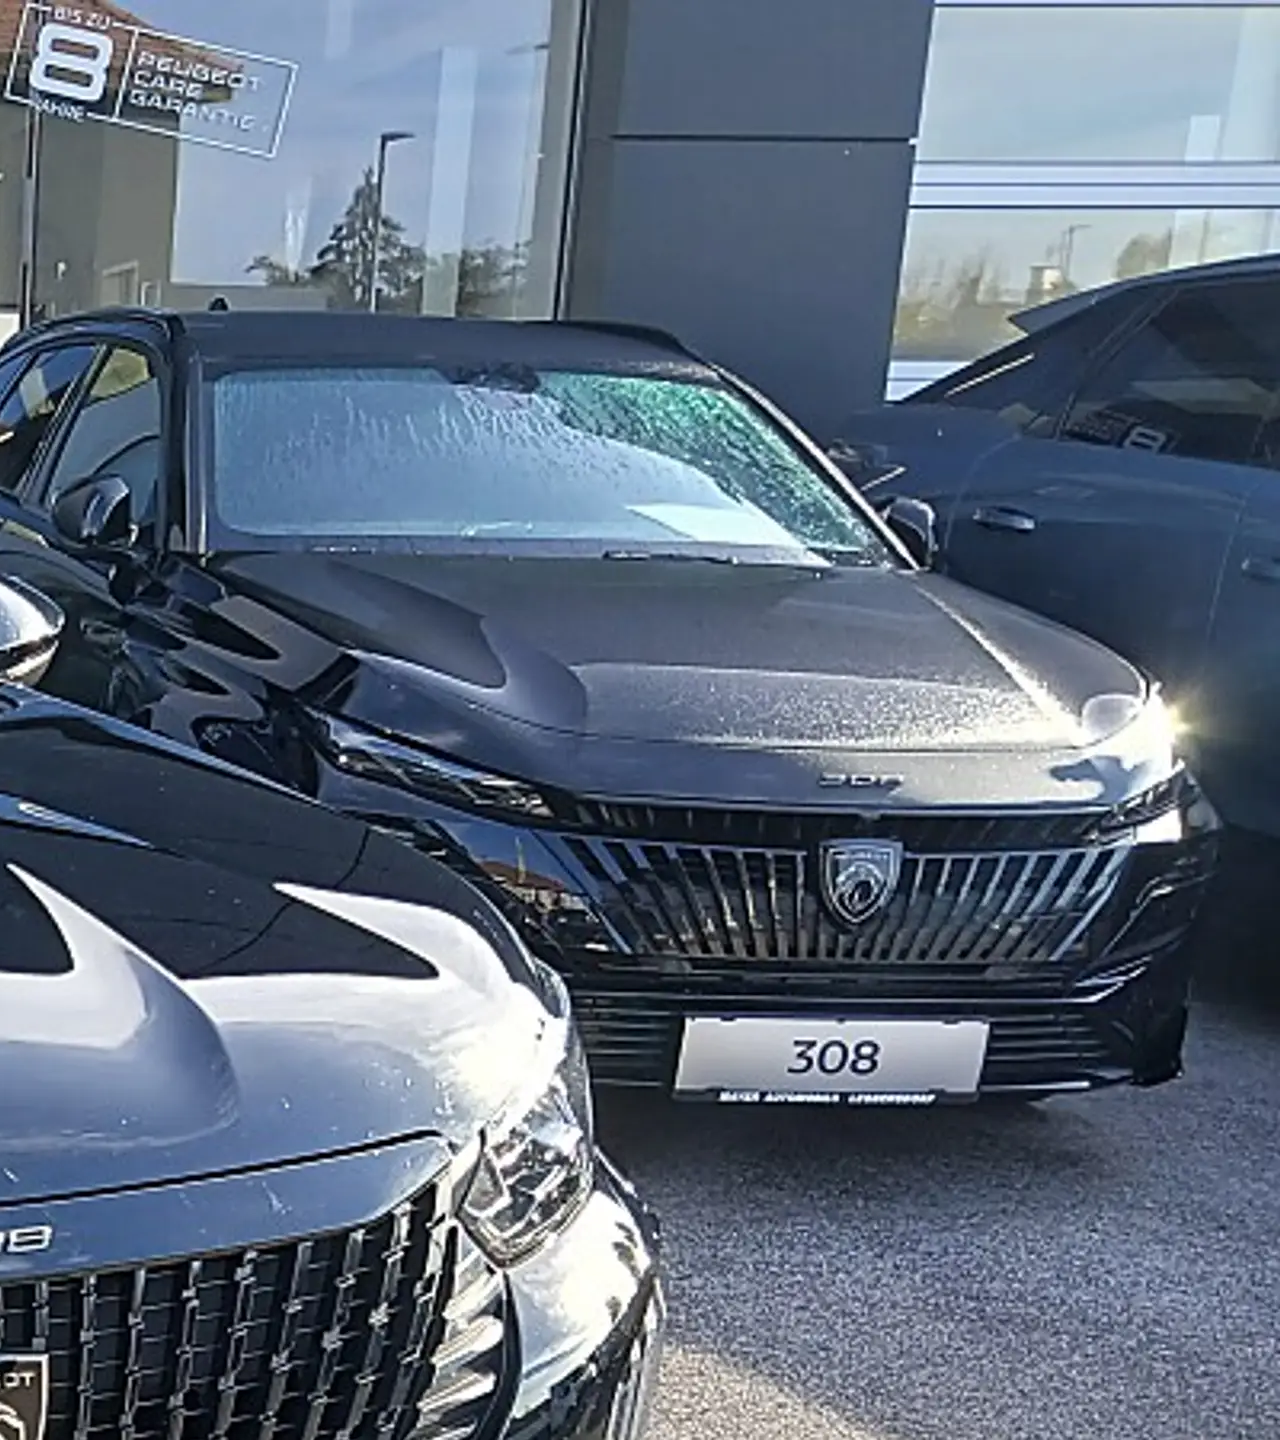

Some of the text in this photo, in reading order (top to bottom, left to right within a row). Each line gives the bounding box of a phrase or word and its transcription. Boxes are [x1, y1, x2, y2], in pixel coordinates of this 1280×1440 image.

[54, 6, 111, 30] BIS ZU
[29, 22, 114, 101] 8
[137, 50, 261, 91] PEUGEOT
[133, 70, 203, 99] CARE
[129, 88, 257, 132] GARANTIE
[787, 1040, 881, 1075] 308
